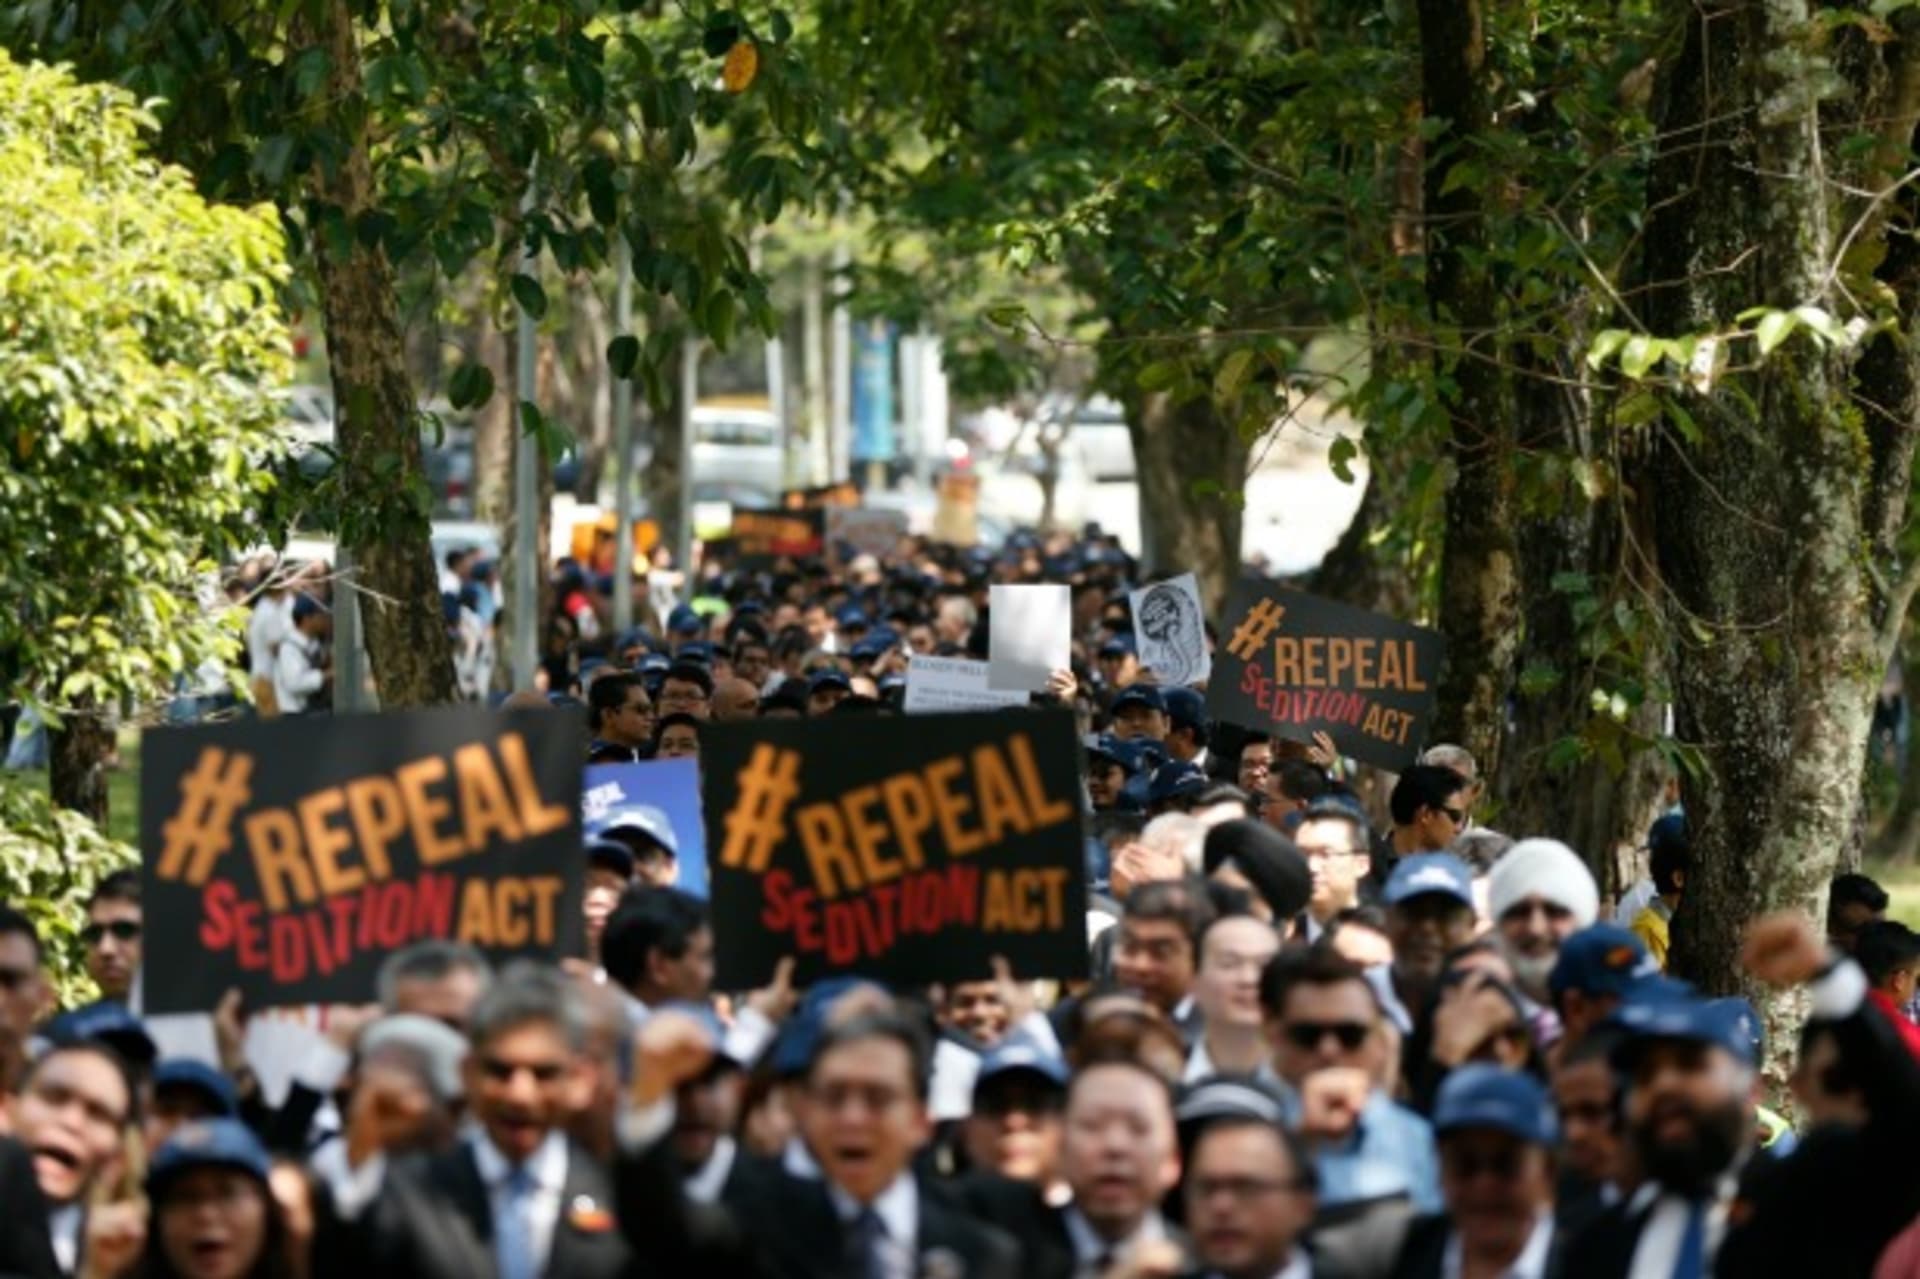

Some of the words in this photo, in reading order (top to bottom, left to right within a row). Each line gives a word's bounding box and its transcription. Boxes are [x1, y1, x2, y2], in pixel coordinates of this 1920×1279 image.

[1226, 597, 1427, 691] #REPEAL
[1241, 662, 1366, 725] SEDITION
[1362, 703, 1415, 746] ACT
[157, 731, 571, 912] #REPEAL
[719, 731, 1072, 897] #REPEAL
[201, 871, 456, 983] SEDITION
[457, 876, 563, 947] ACT
[761, 864, 979, 965] SEDITION
[983, 868, 1068, 931] ACT
